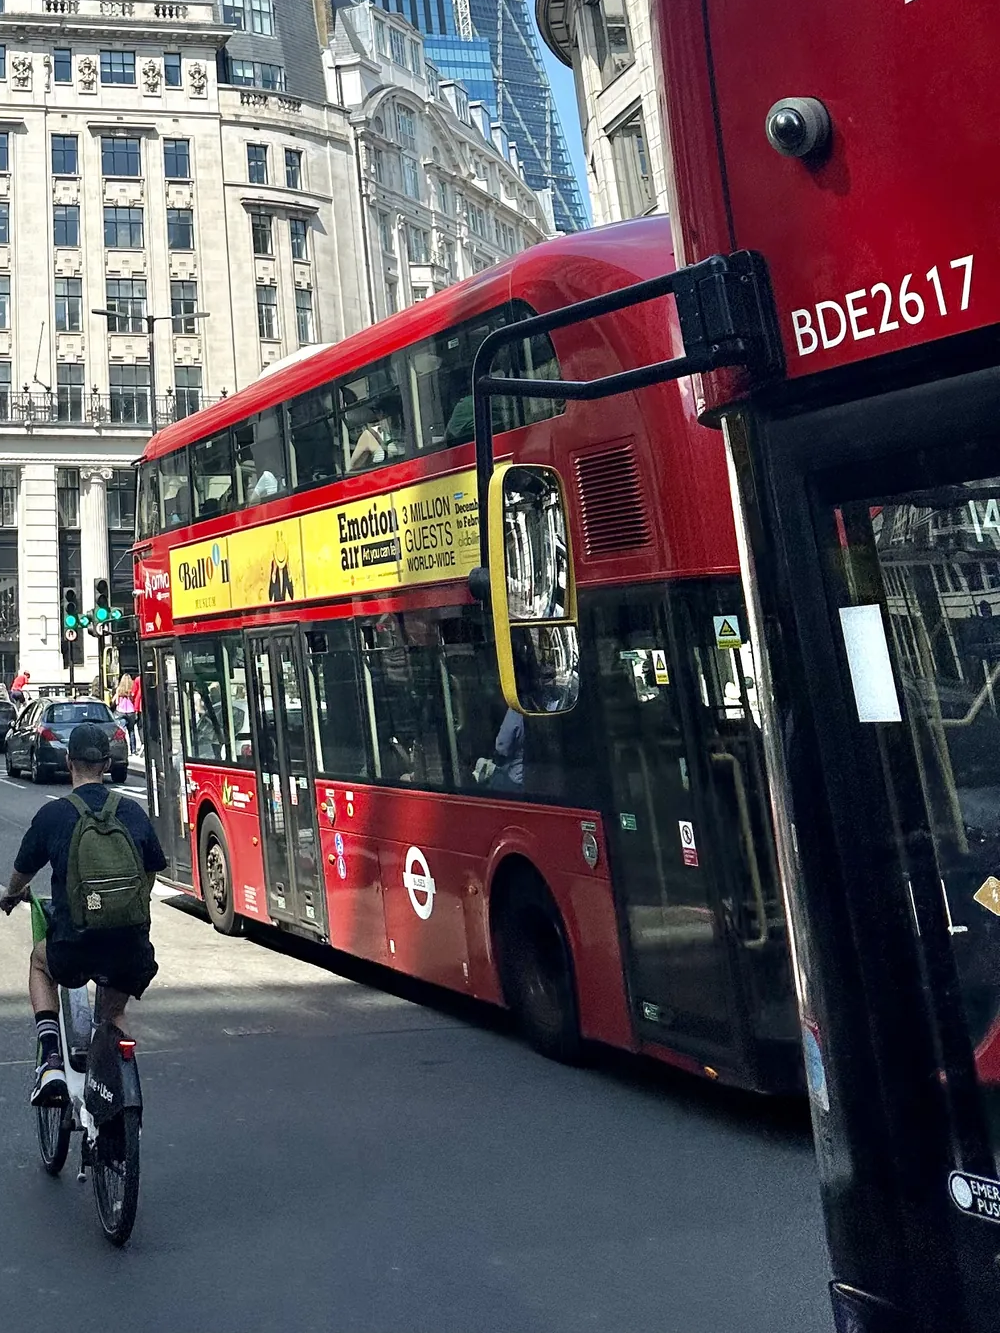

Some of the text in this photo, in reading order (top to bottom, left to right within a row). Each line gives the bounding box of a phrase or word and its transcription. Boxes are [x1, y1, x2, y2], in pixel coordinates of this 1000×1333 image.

[791, 254, 974, 356] BDE2617
[402, 495, 450, 524] 3 MILLION
[454, 498, 479, 515] Decemb
[337, 503, 399, 543] Emotion
[456, 514, 479, 529] to Febr
[405, 521, 453, 553] GUESTS
[340, 543, 359, 571] air
[407, 550, 456, 571] WORLD-WIDE
[100, 1083, 113, 1103] Uber
[970, 1180, 1000, 1200] EMER
[977, 1198, 1000, 1217] PUS
